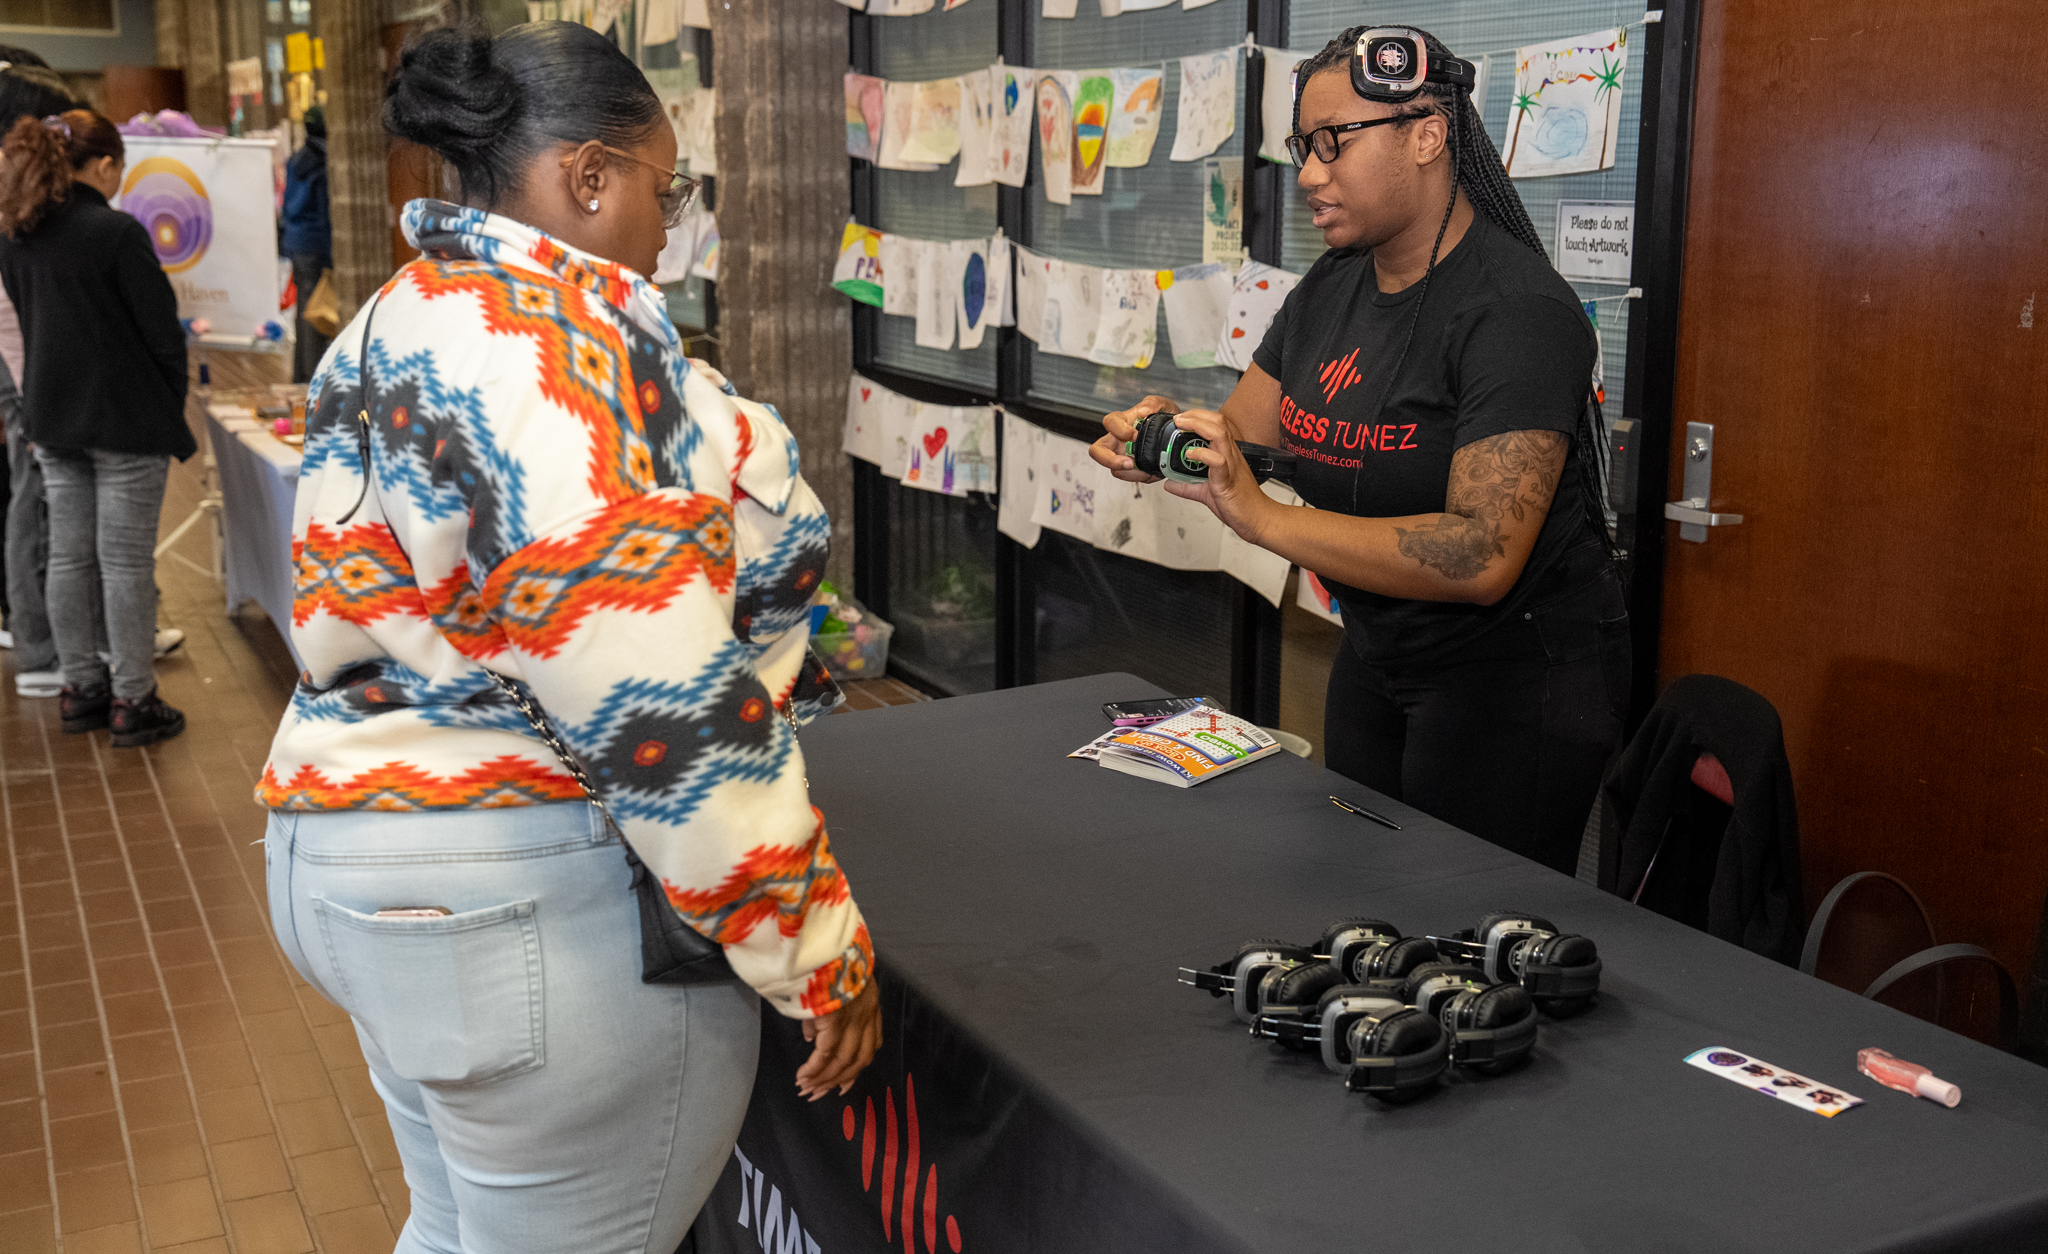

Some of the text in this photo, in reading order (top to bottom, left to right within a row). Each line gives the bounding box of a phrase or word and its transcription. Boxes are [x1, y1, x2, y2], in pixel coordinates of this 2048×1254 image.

[1571, 215, 1628, 231] Please do not
[1566, 236, 1628, 256] touch Artwork
[179, 280, 230, 302] Haven
[1333, 420, 1418, 452] TUNEZ
[1128, 732, 1172, 745] CIRCLE
[1200, 734, 1243, 756] JUMBO
[1155, 744, 1179, 758] Book
[1184, 750, 1214, 770] FIND
